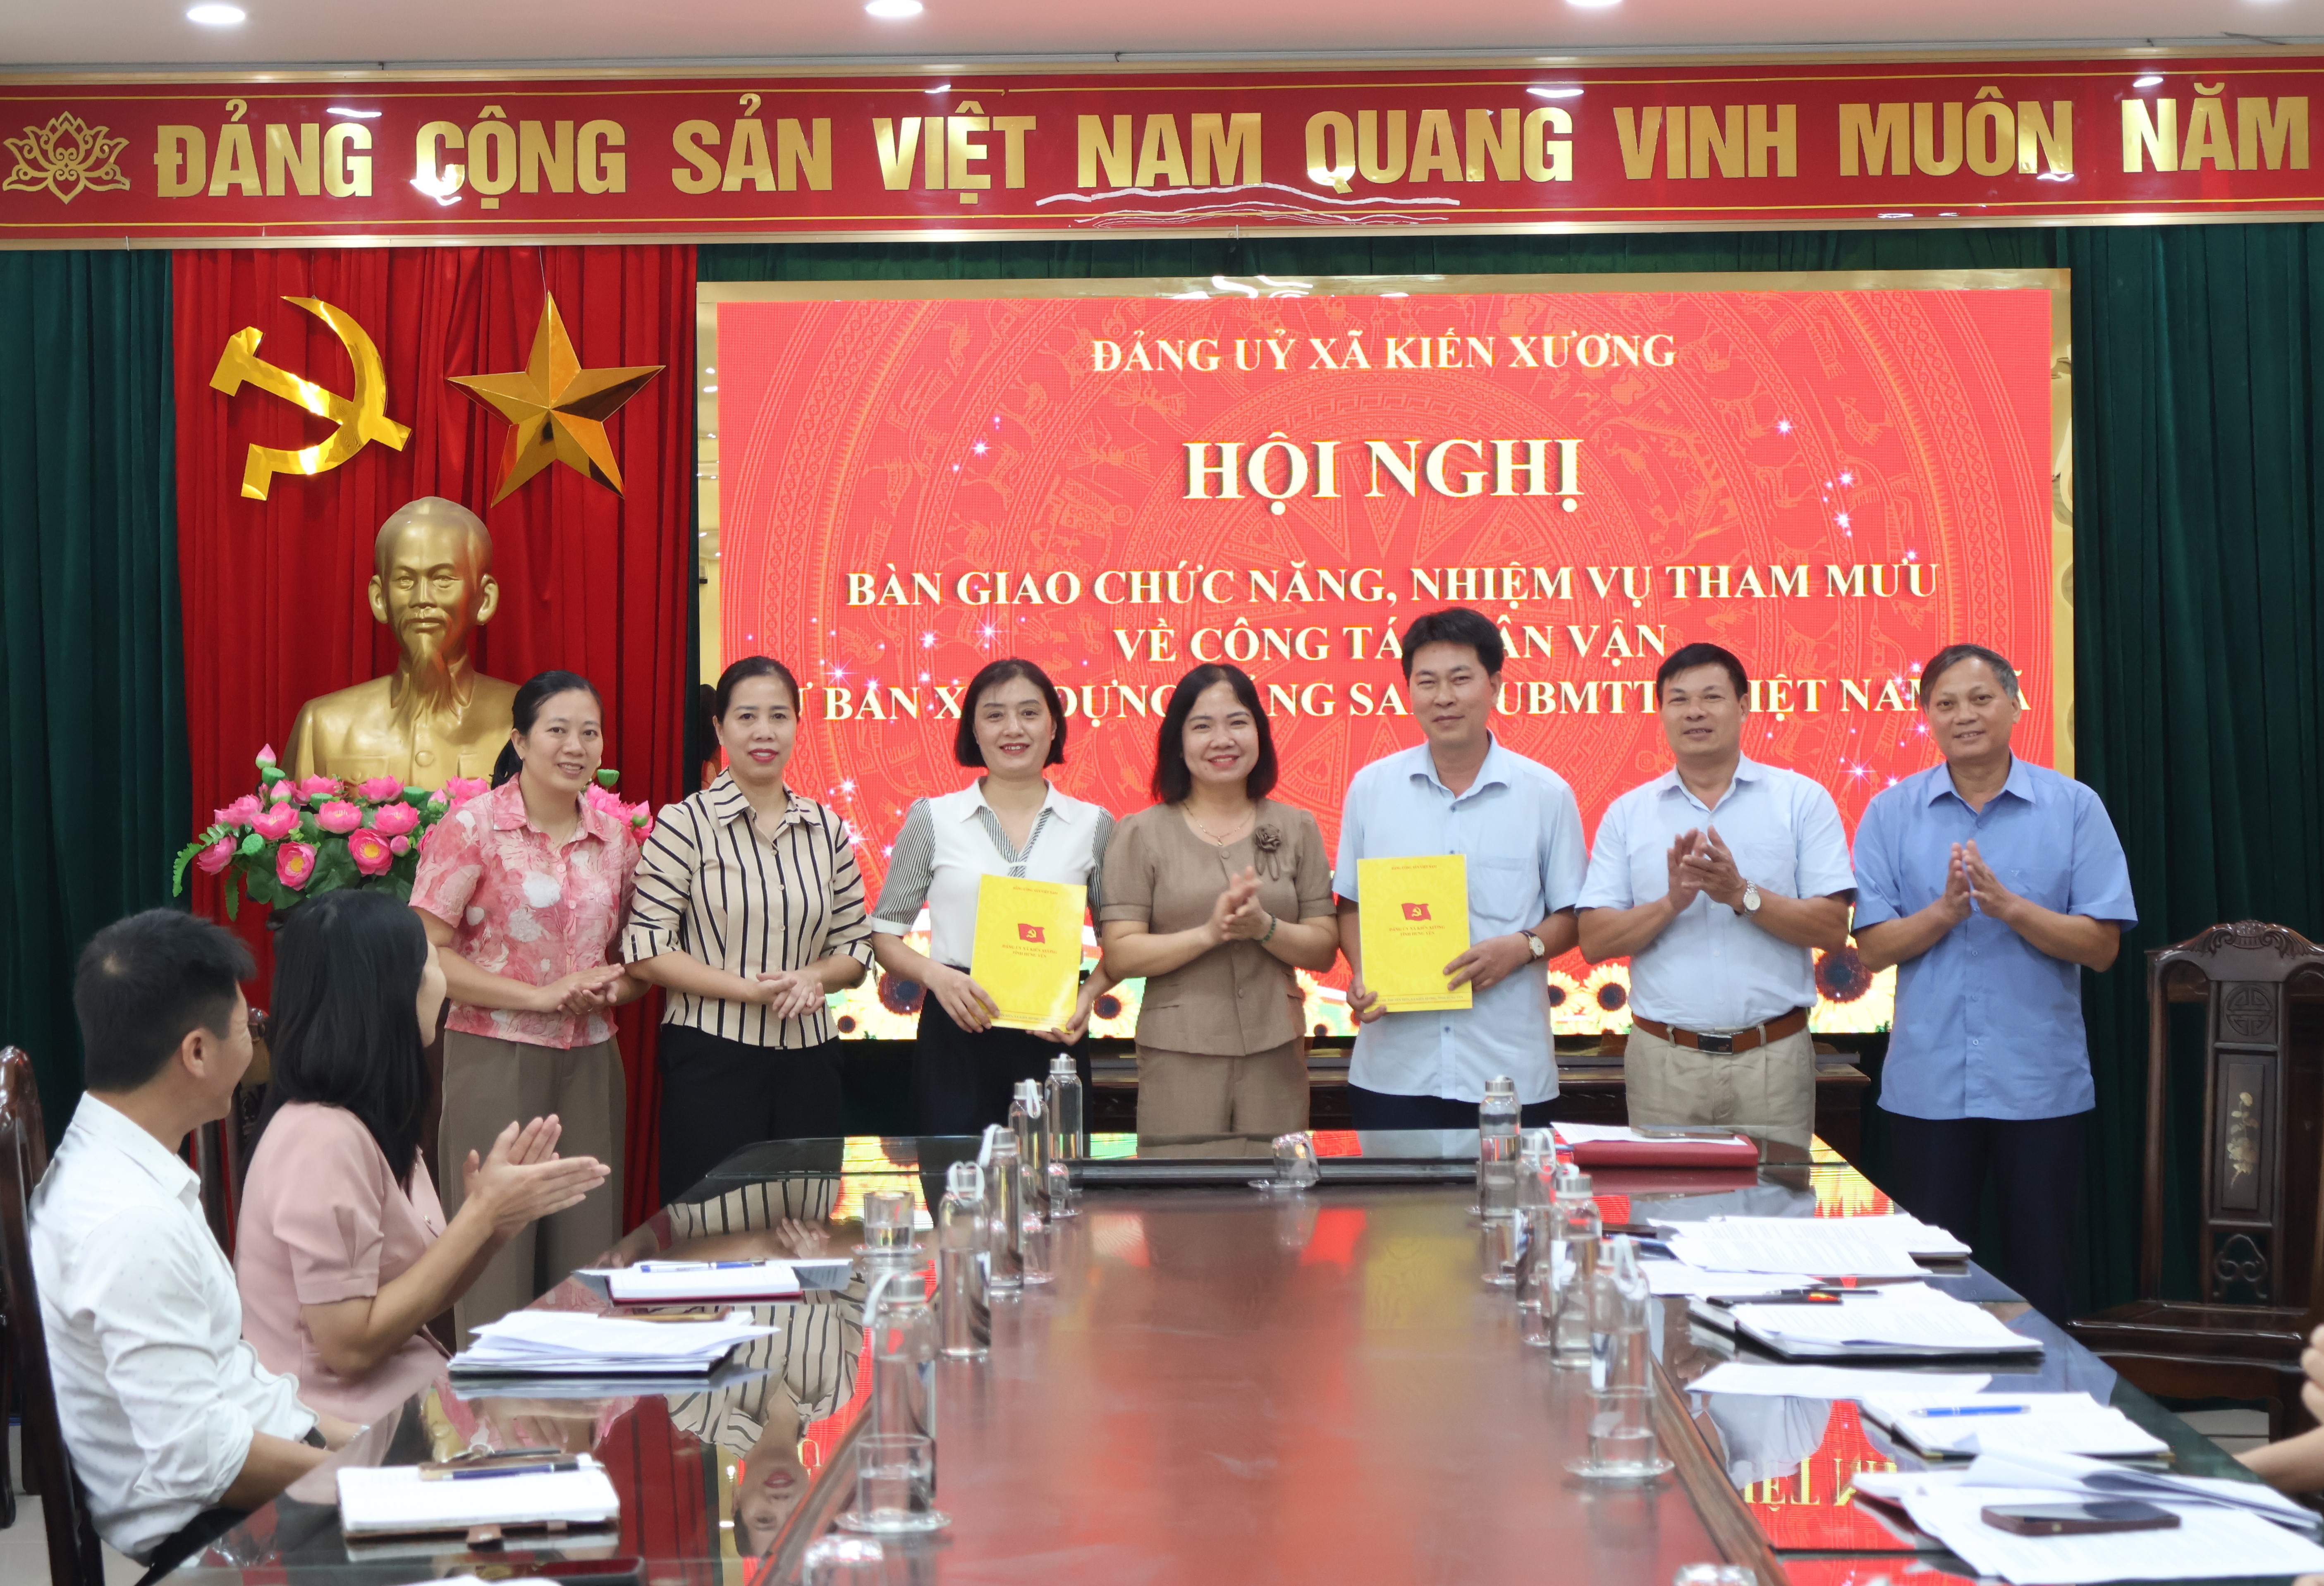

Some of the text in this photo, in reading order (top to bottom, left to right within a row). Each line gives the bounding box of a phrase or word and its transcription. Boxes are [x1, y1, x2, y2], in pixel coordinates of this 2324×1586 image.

[153, 82, 2309, 209] ĐẢNG CỘNG SẢN VIỆT NAM QUANG VINH MUÔN NĂM
[1091, 328, 1676, 371] ĐẢNG UỶ XÃ KIẾN XƯƠNG
[1182, 431, 1585, 516] HỘI NGHỊ
[846, 557, 1939, 610] BÀN GIAO CHỨC NĂNG, NHIỆM VỤ THAM MƯU
[1113, 615, 1666, 667] VỀ CÔNG TÁ ÂN VẬN
[1268, 683, 1335, 716] NG
[1350, 683, 1413, 716] SA
[1496, 681, 1656, 715] UBMTT
[1749, 673, 1827, 721] IỆT
[1840, 677, 1921, 712] NA
